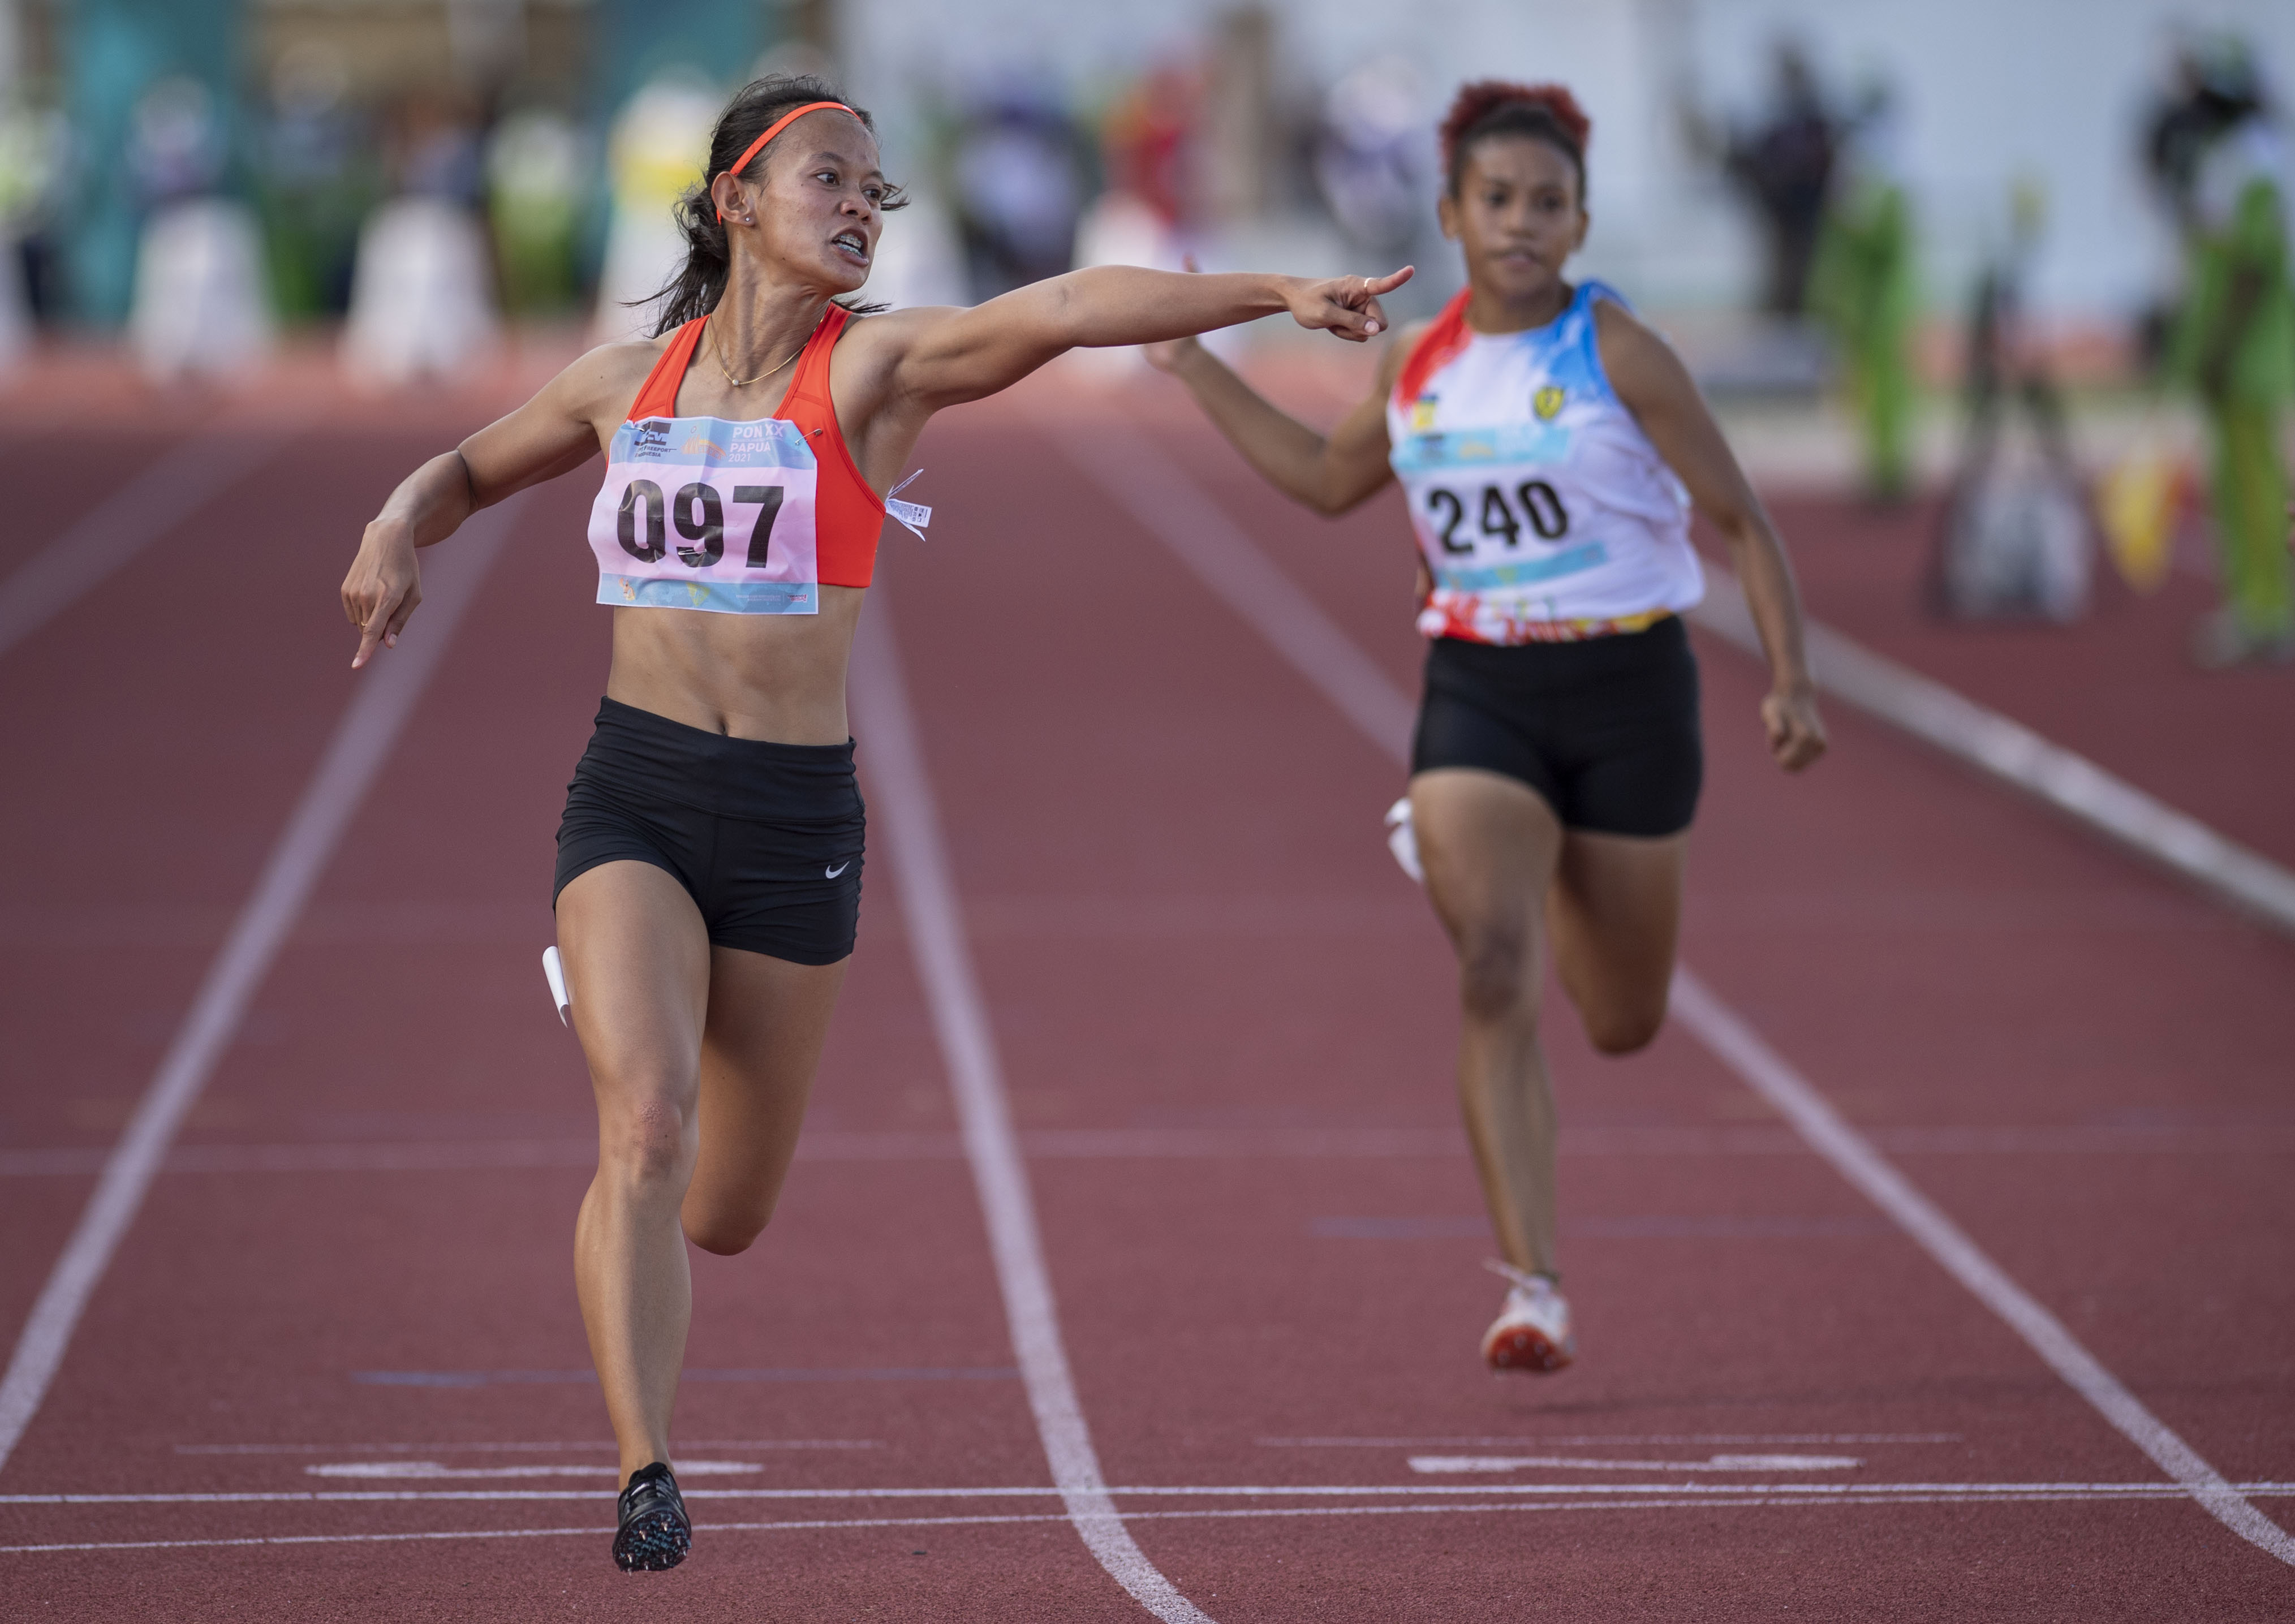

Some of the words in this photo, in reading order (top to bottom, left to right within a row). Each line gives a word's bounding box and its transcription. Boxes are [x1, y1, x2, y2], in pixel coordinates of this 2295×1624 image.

[733, 425, 763, 438] PON
[765, 424, 784, 437] XX
[730, 441, 772, 453] PAPUA
[728, 453, 751, 462] 2021
[1428, 479, 1568, 554] 240
[617, 479, 785, 569] 097
